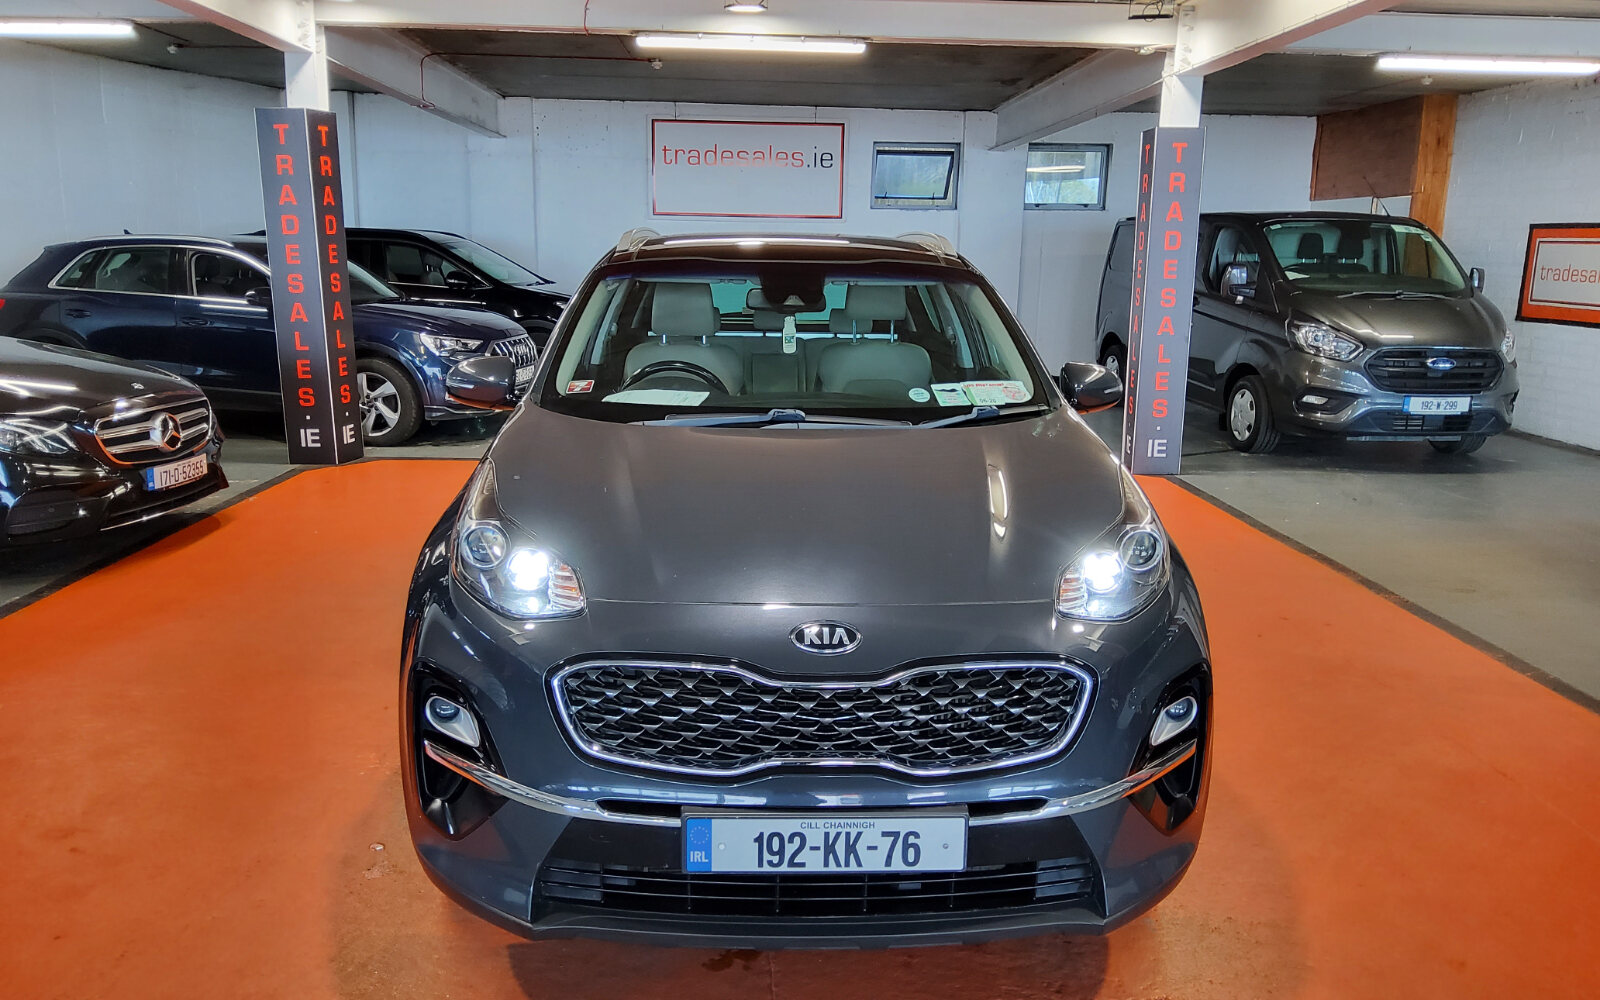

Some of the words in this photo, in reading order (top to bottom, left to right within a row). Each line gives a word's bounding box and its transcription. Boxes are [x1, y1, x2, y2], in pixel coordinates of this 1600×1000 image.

[662, 143, 834, 169] tradesales.ie
[160, 459, 204, 487] 171-D-52355
[803, 626, 850, 645] KIA
[800, 821, 821, 829] CILL
[823, 821, 876, 829] CHAINNIGH
[689, 850, 709, 863] IRL
[753, 831, 921, 869] 192-KK-76
